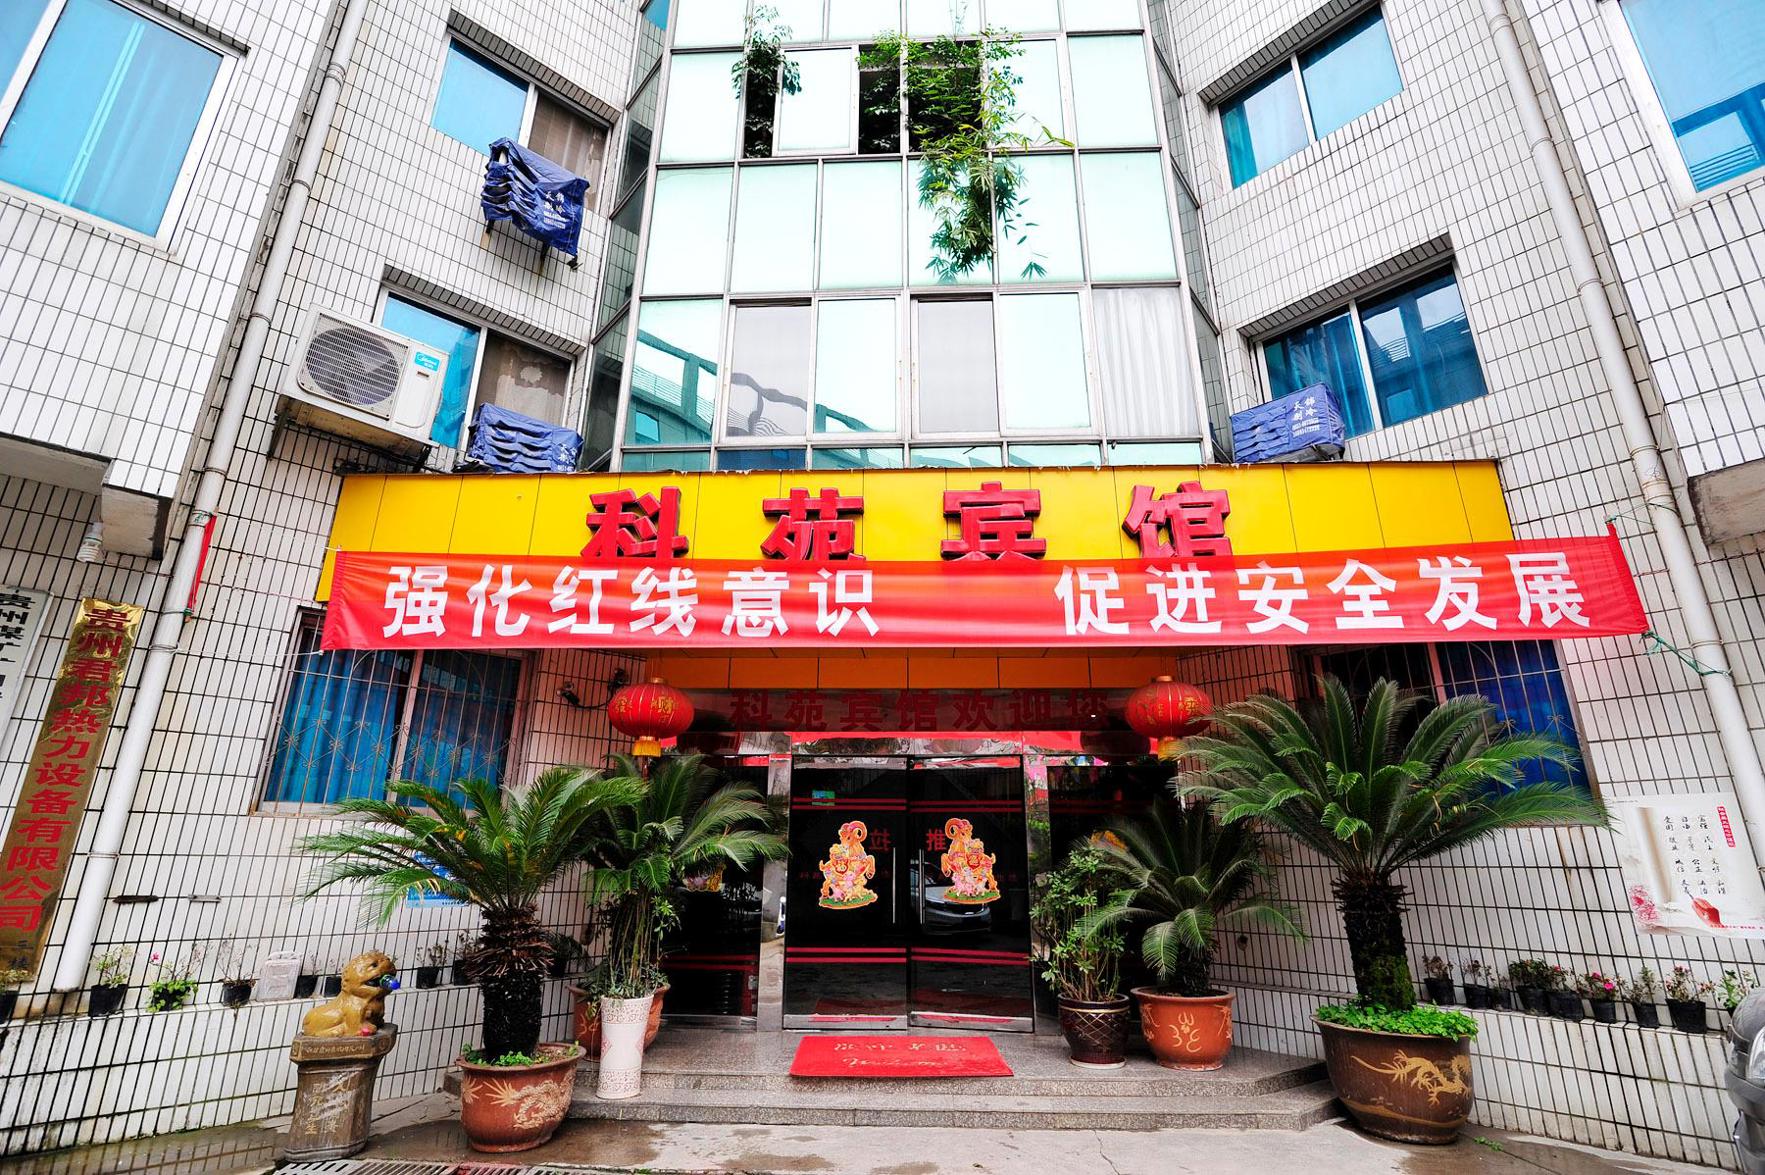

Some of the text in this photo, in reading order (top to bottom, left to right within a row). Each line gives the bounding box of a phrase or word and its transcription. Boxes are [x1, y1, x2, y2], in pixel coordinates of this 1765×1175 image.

[581, 481, 1233, 560] 科苑宾馆
[383, 550, 1593, 638] 强化红线意识 促进安全发展
[729, 688, 1110, 732] 科苑宾馆欢迎您
[0, 608, 131, 933] 贵州君邦热力设备有限公司
[926, 828, 947, 852] 推
